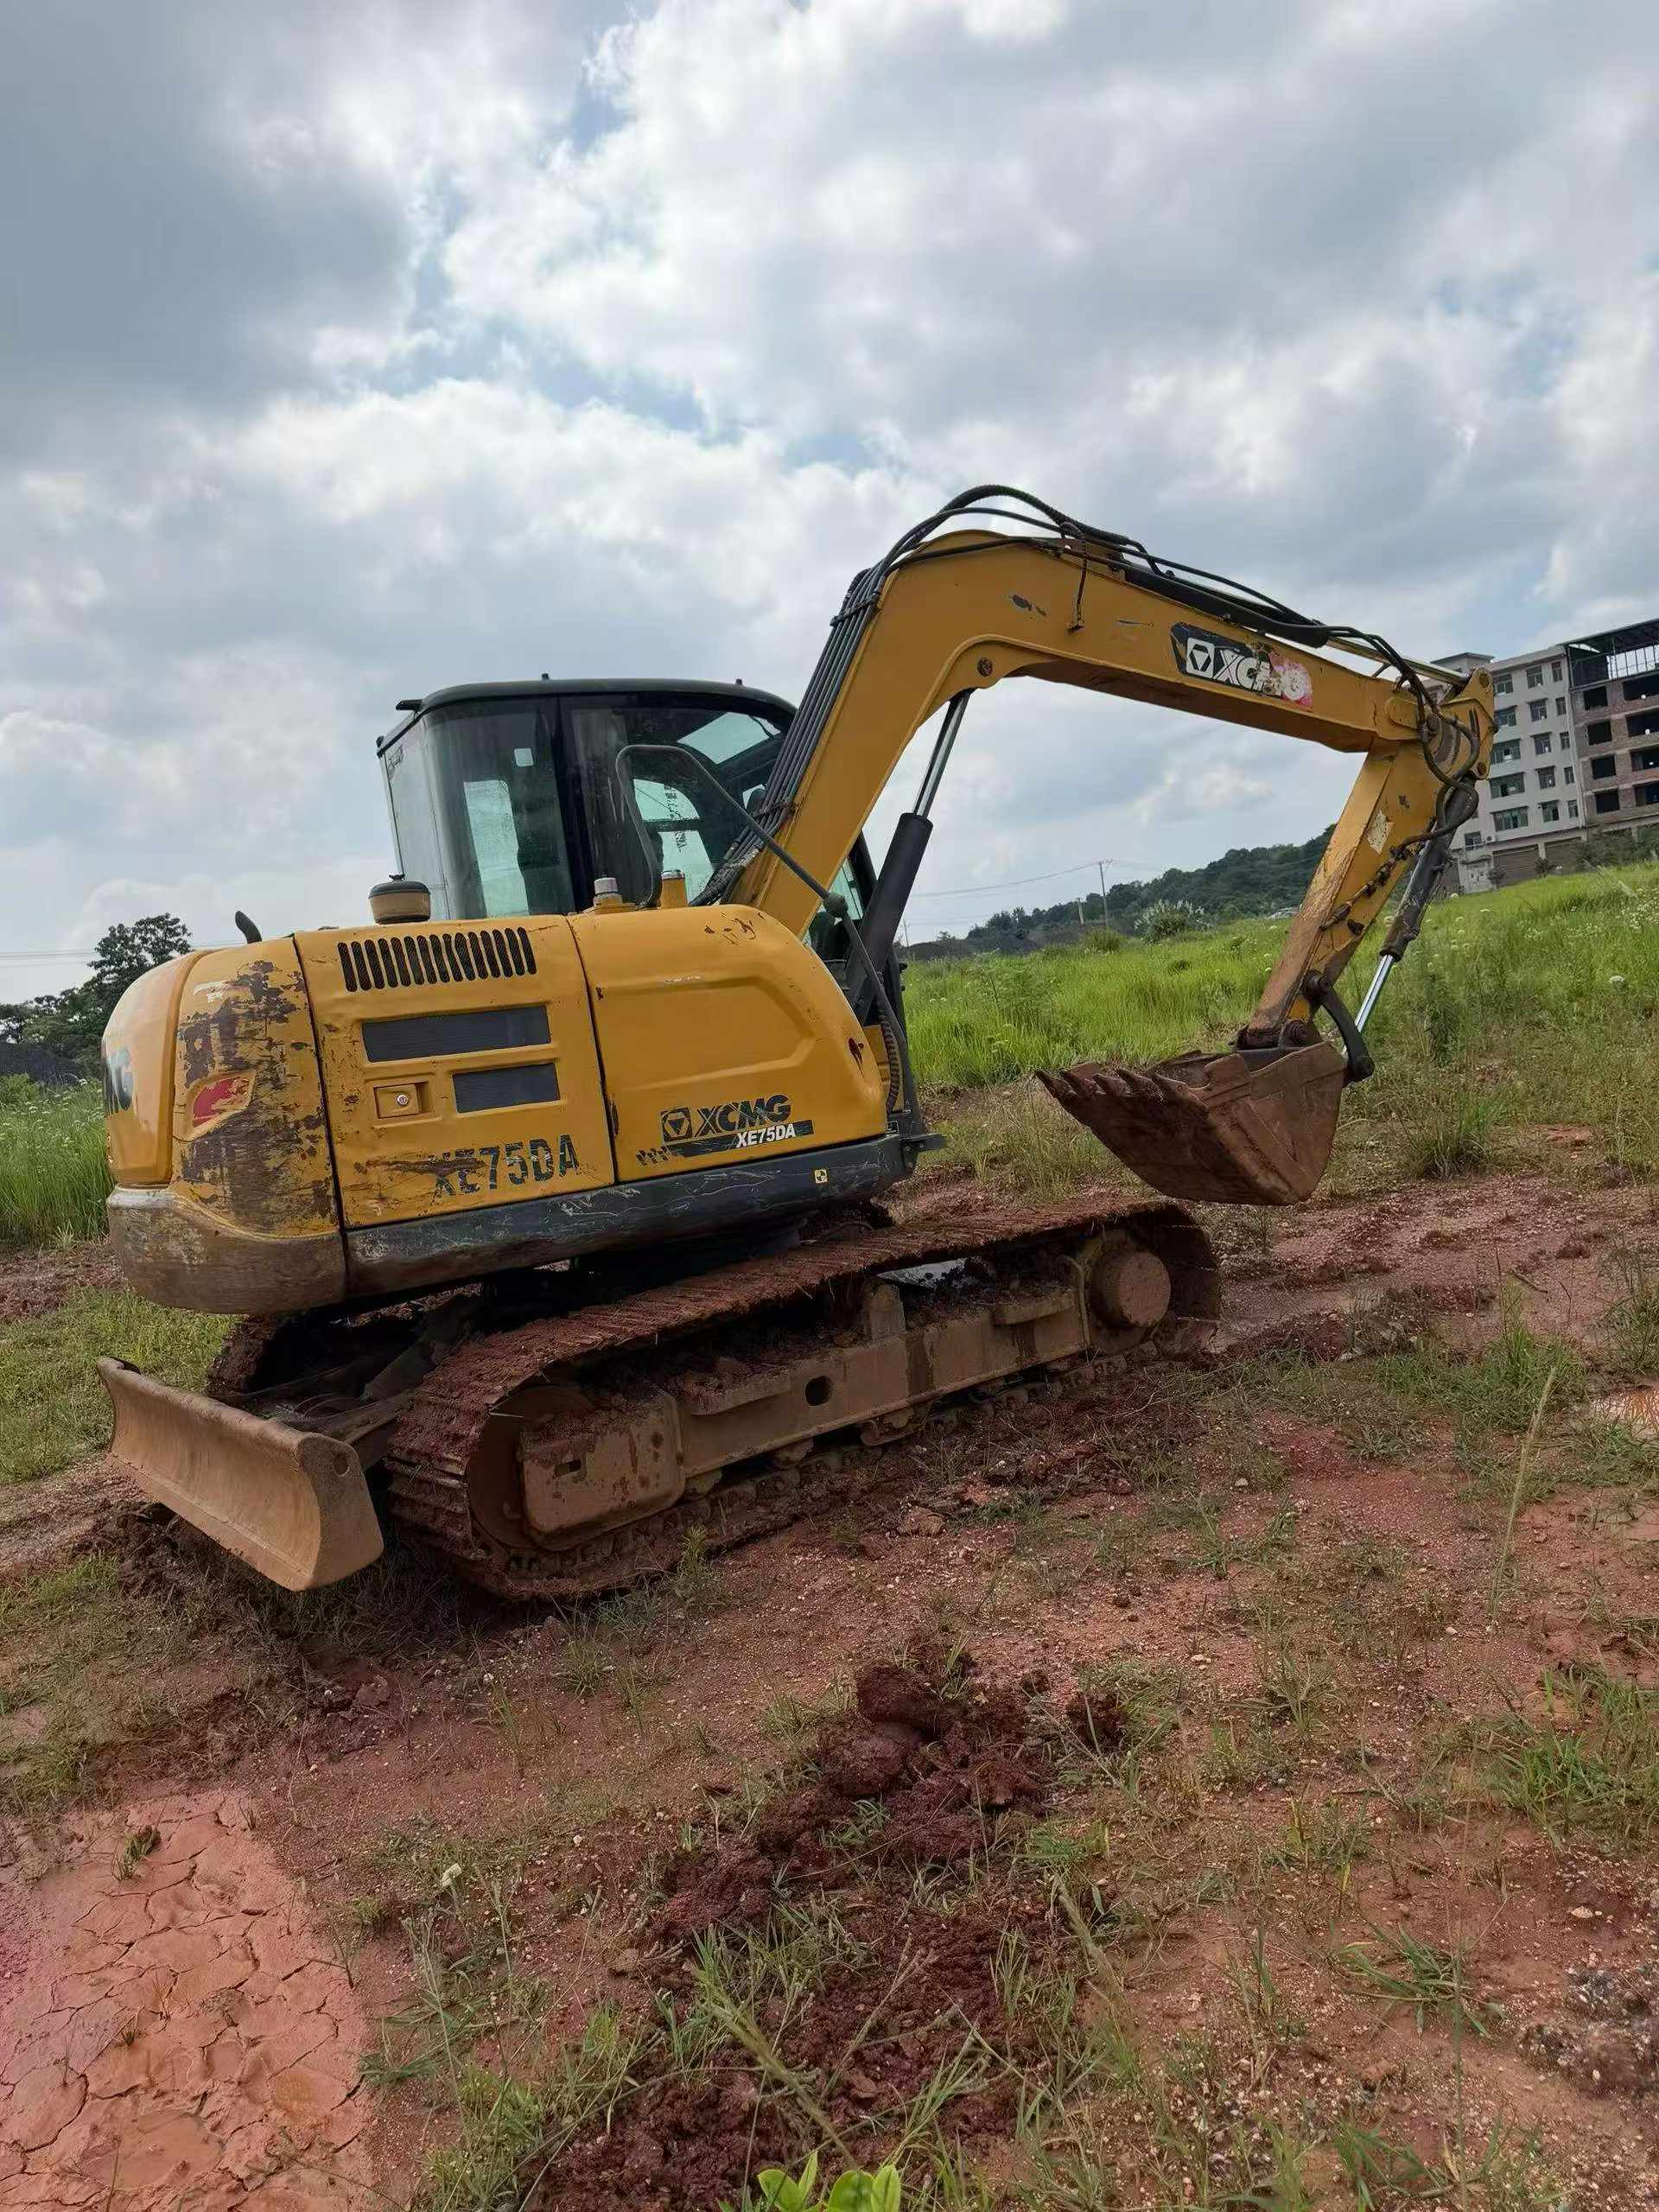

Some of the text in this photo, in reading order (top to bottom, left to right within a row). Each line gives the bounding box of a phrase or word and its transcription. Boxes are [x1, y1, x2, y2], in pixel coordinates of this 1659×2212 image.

[1212, 649, 1312, 701] XC
[695, 1094, 791, 1137] XCMG
[735, 1122, 796, 1147] XE75DA
